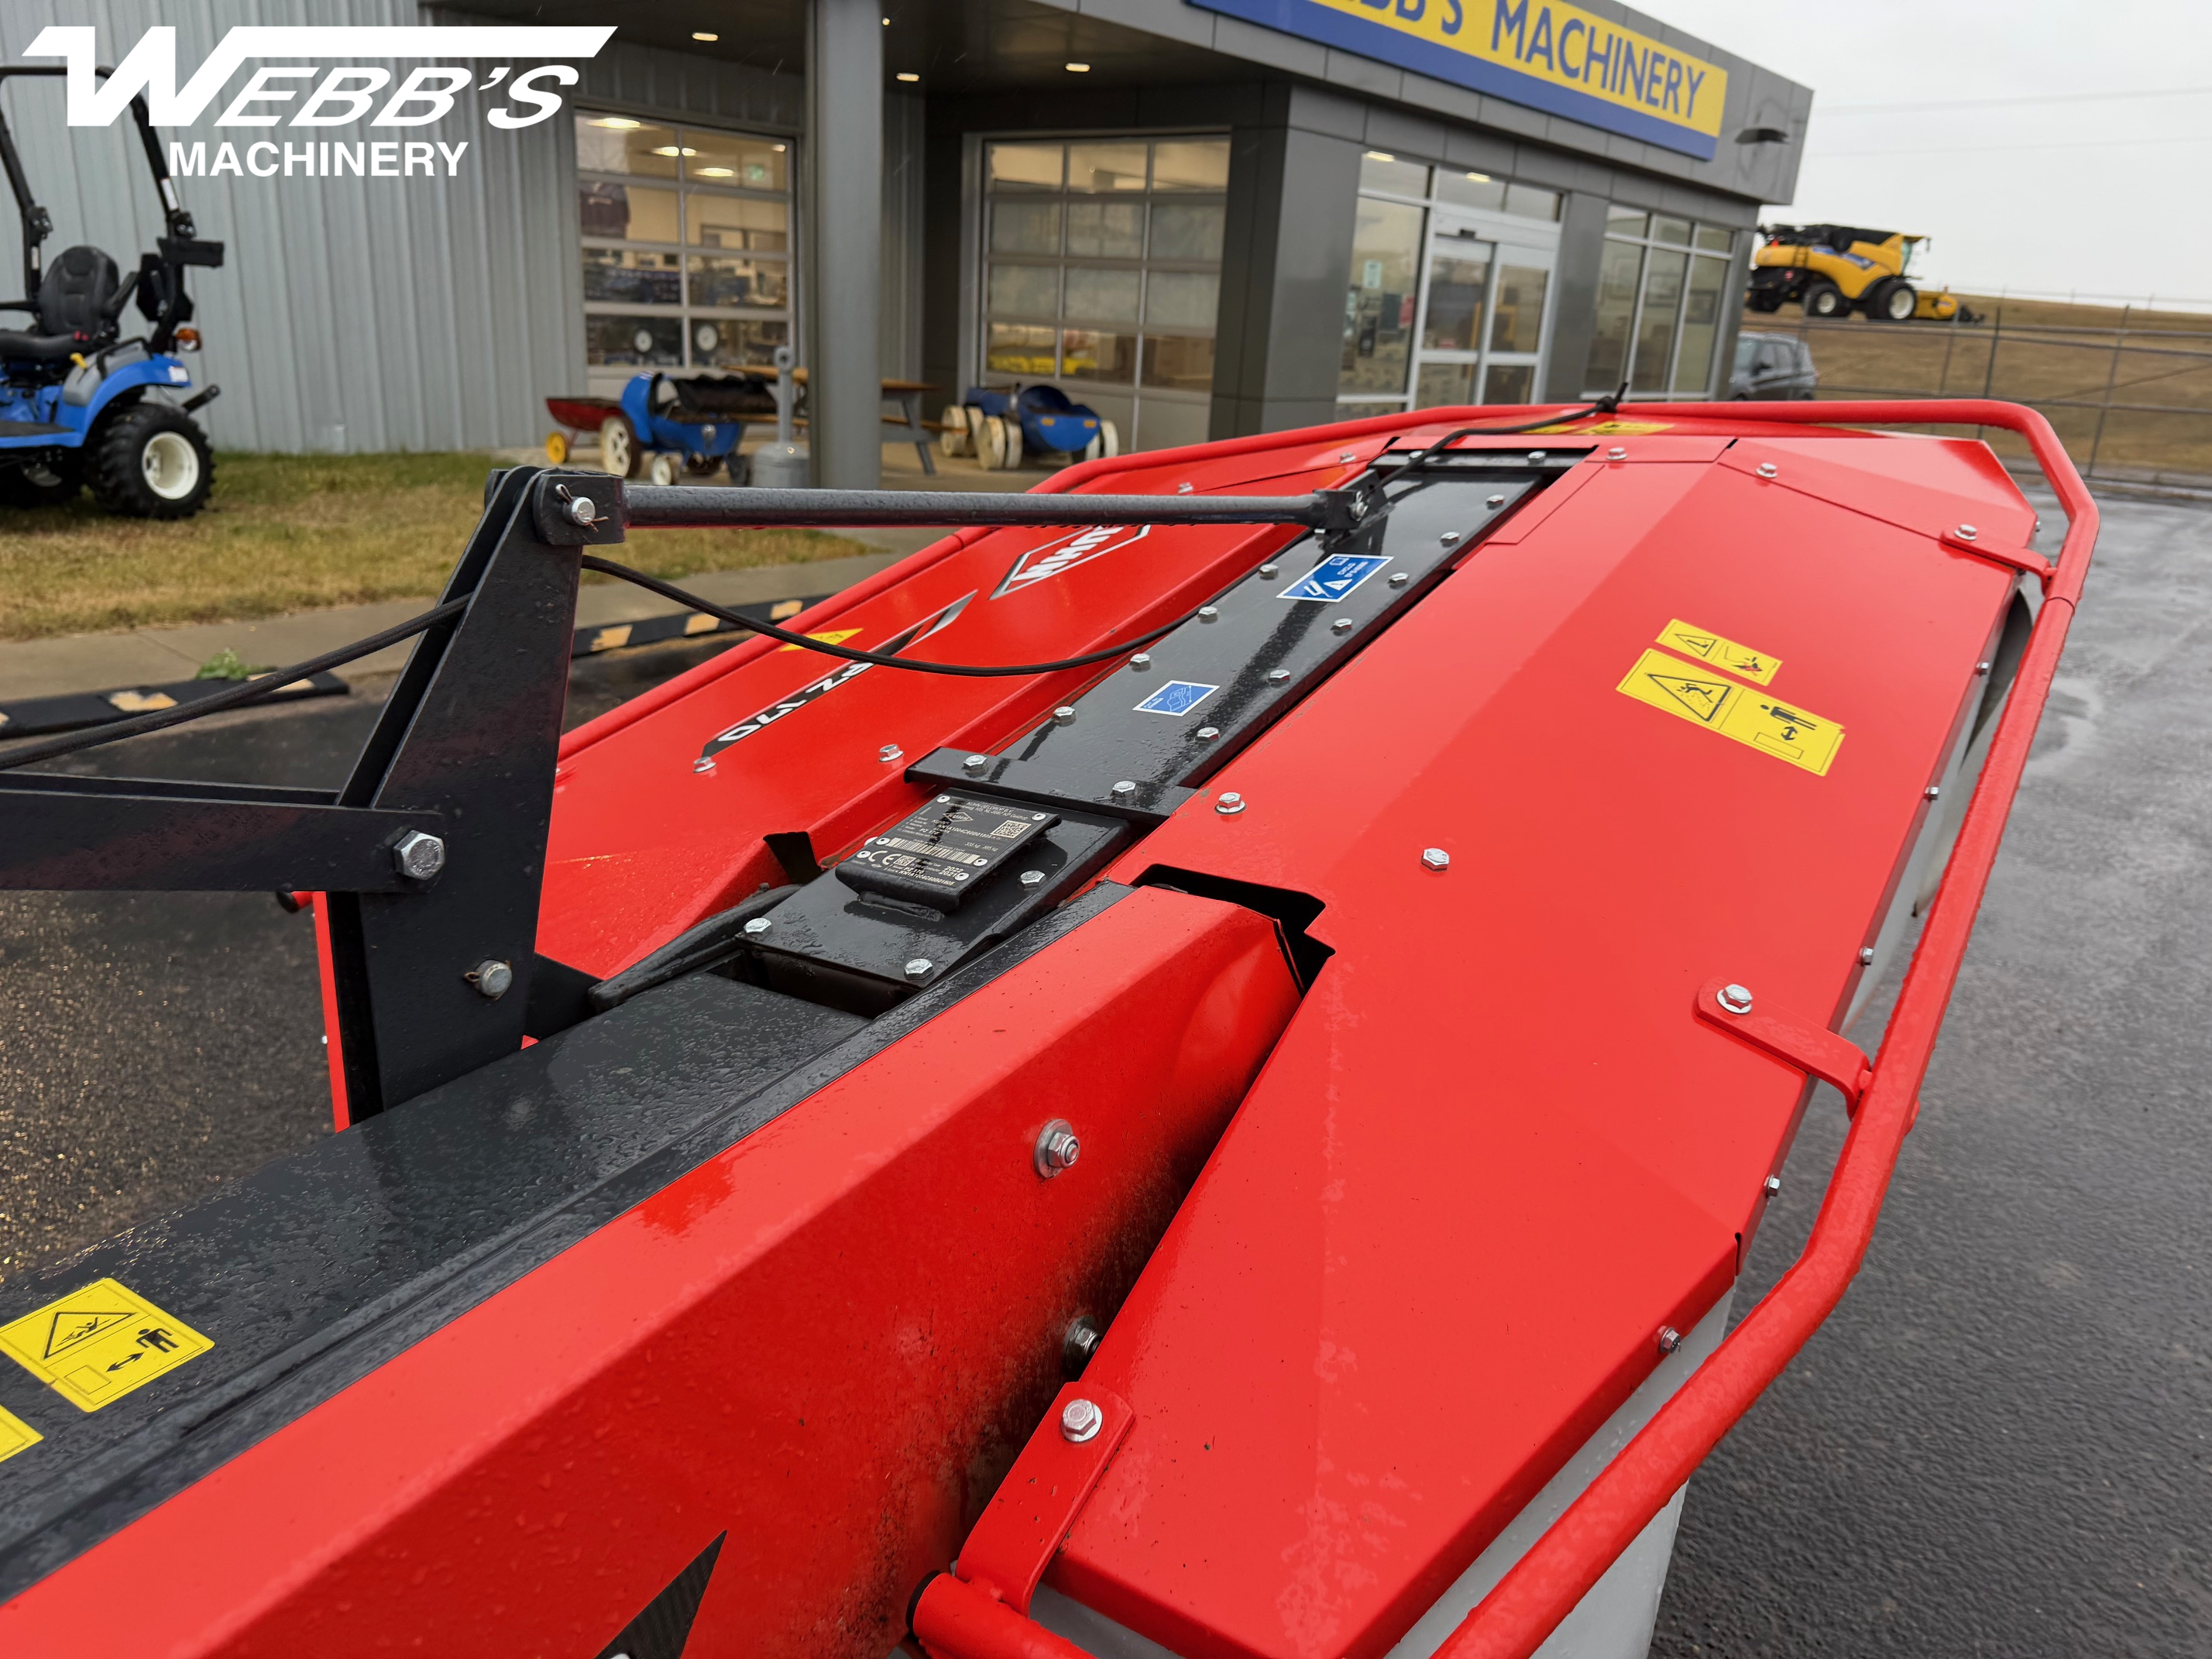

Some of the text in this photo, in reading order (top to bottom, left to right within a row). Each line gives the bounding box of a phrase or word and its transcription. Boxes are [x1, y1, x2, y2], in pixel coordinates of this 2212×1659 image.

[1491, 0, 1706, 119] MACHINERY
[717, 699, 807, 742] 170
[938, 869, 958, 878] 2021
[944, 865, 964, 874] 2022
